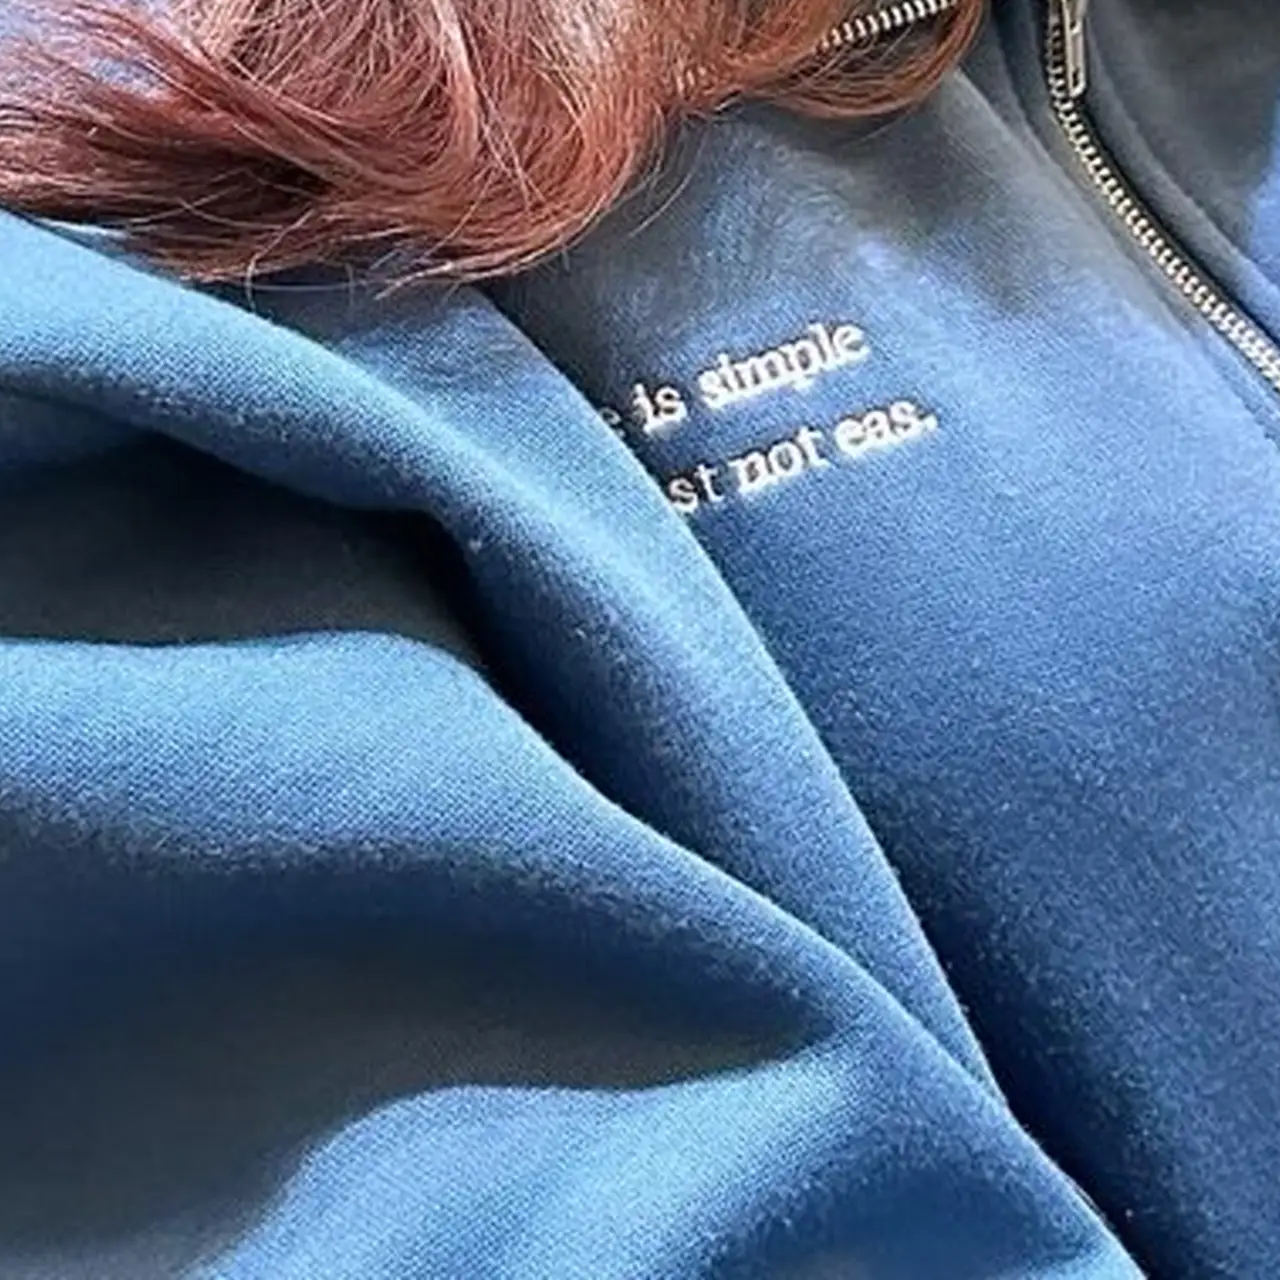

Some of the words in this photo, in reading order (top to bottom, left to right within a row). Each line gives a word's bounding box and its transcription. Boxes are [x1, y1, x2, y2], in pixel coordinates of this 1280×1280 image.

[632, 382, 689, 434] is
[698, 321, 870, 410] simple
[667, 462, 725, 516] st
[728, 425, 831, 495] not
